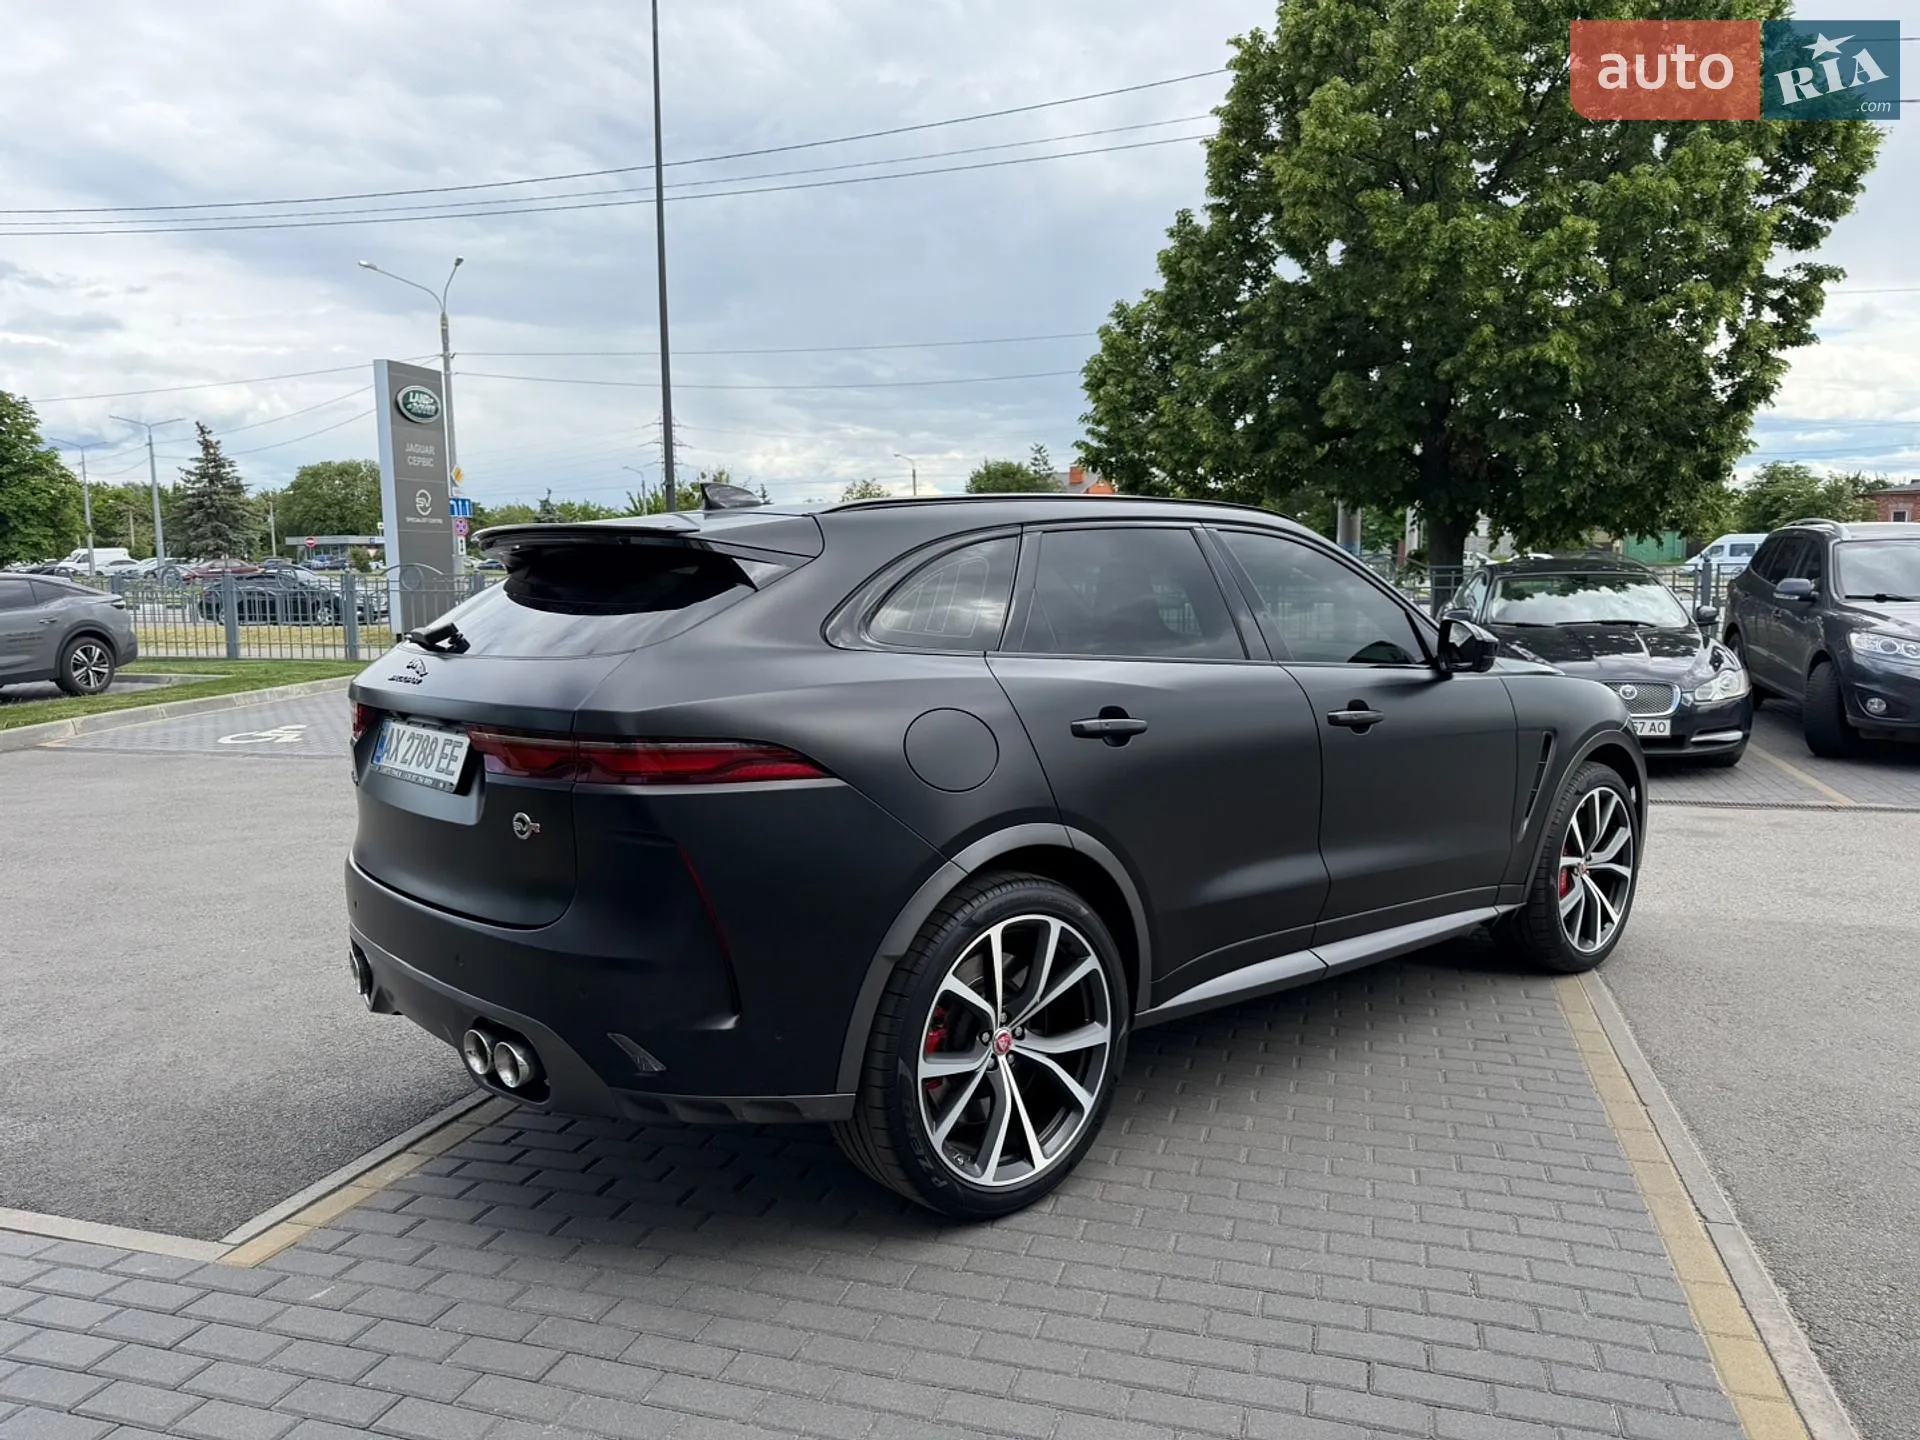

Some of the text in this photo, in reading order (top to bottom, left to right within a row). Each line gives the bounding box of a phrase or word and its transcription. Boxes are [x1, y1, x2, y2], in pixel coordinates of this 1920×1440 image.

[408, 391, 434, 405] LAND
[406, 443, 436, 456] JAGUAR
[407, 456, 435, 468] СЕРВІС
[1648, 721, 1666, 733] AO
[384, 727, 406, 763] AX
[400, 731, 439, 770] 2788
[436, 738, 464, 776] EE
